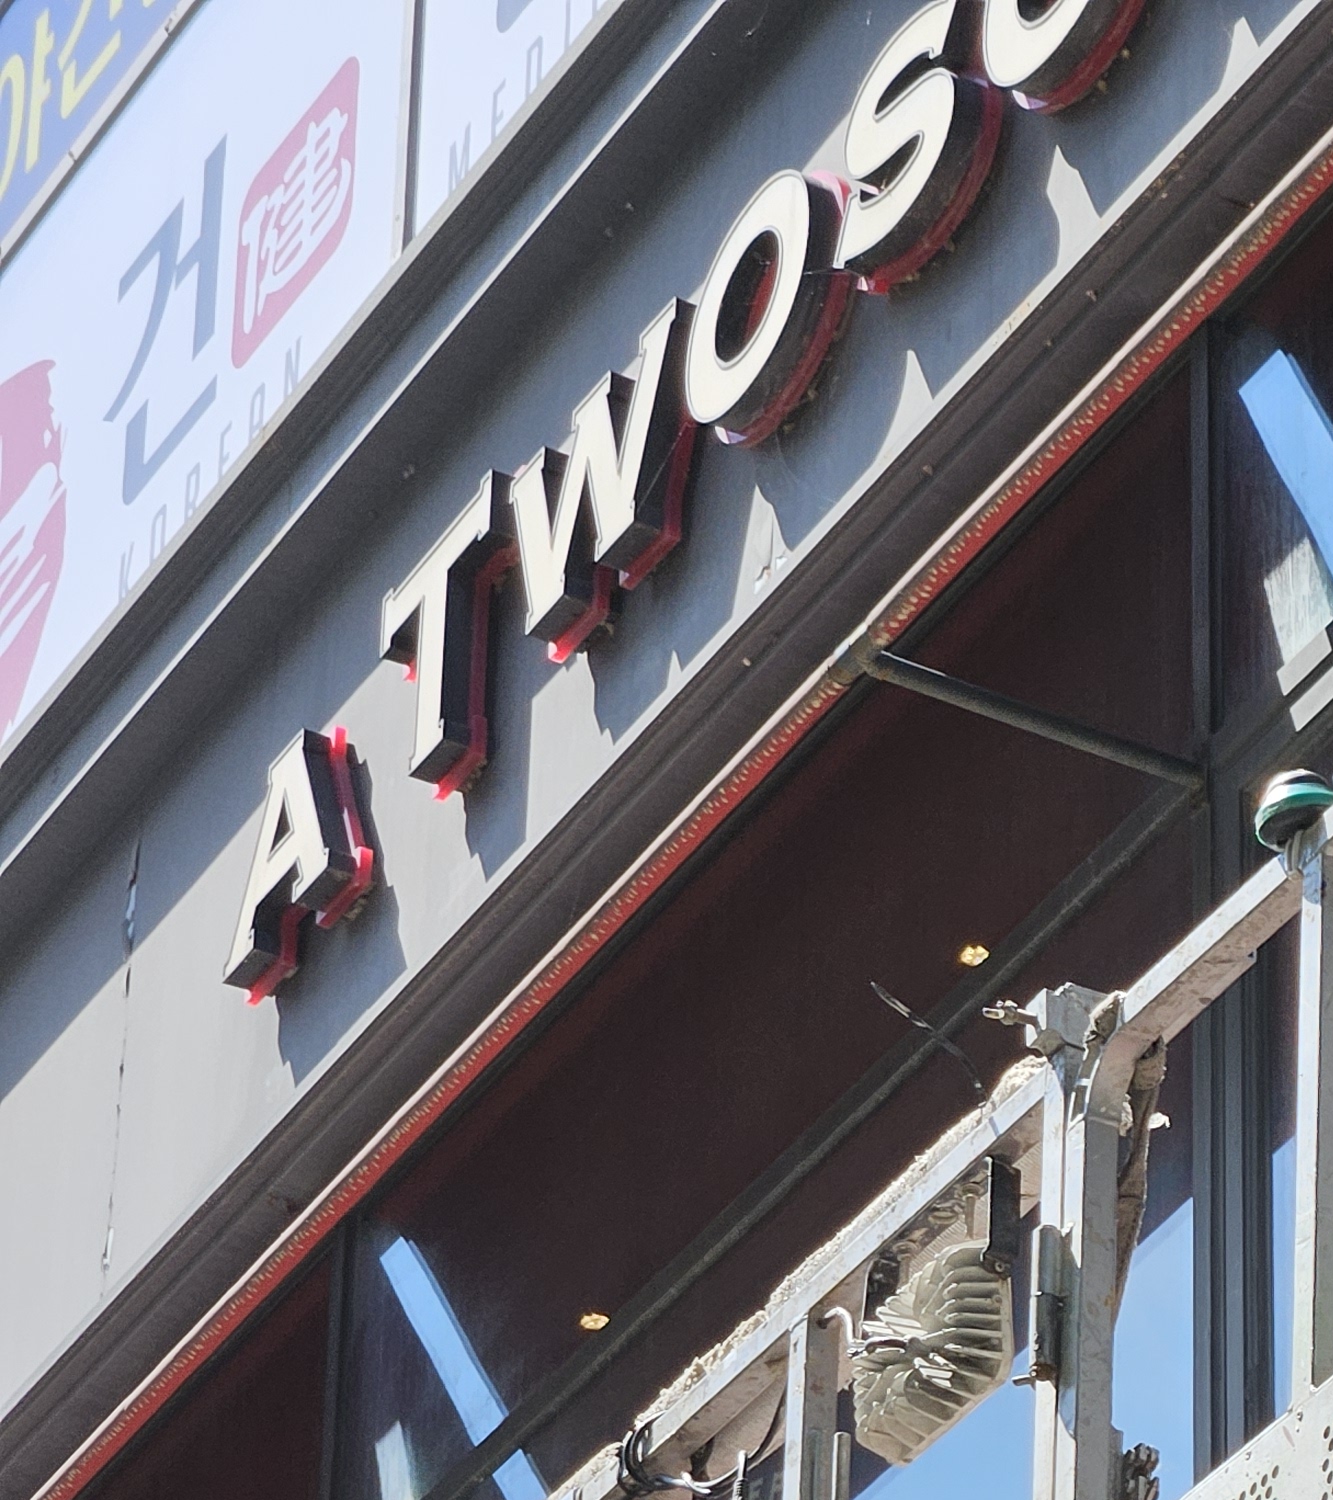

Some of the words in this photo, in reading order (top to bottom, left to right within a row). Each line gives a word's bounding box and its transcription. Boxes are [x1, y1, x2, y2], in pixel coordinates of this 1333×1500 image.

[102, 132, 228, 506] 건
[118, 335, 302, 601] KOREAN
[447, 0, 598, 197] MEDI
[223, 727, 362, 998] A
